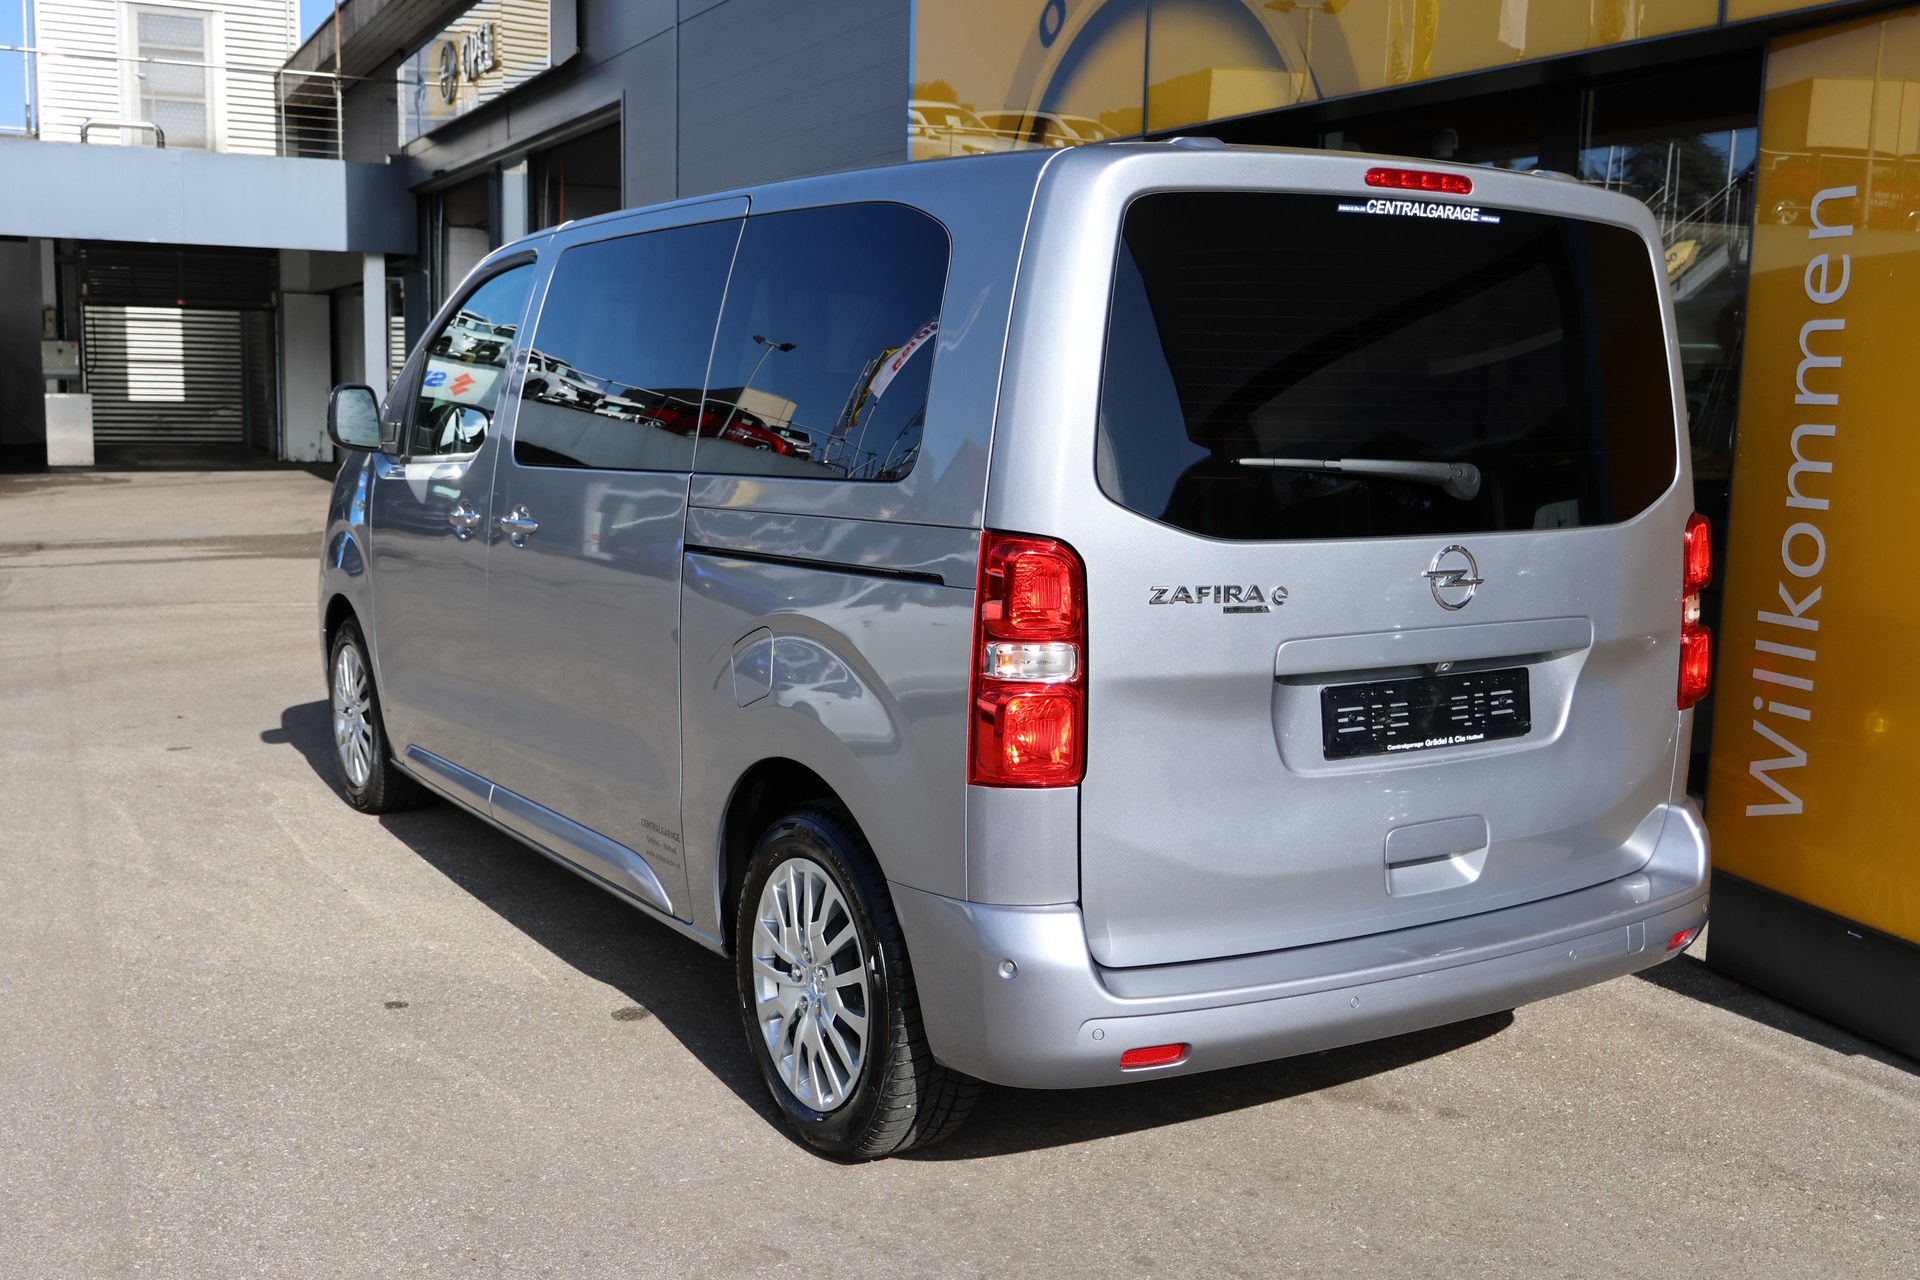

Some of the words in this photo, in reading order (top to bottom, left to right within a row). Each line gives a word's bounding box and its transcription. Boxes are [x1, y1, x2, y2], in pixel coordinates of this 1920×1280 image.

[462, 22, 493, 82] OPEL
[1366, 199, 1480, 222] CENTRALGARAGE
[1745, 184, 1857, 817] Willkommen
[1149, 584, 1266, 605] ZAFIRA
[1387, 741, 1424, 751] Centralgarage
[1425, 737, 1447, 747] Grädel
[1448, 736, 1454, 744] &
[1454, 735, 1466, 743] Cie
